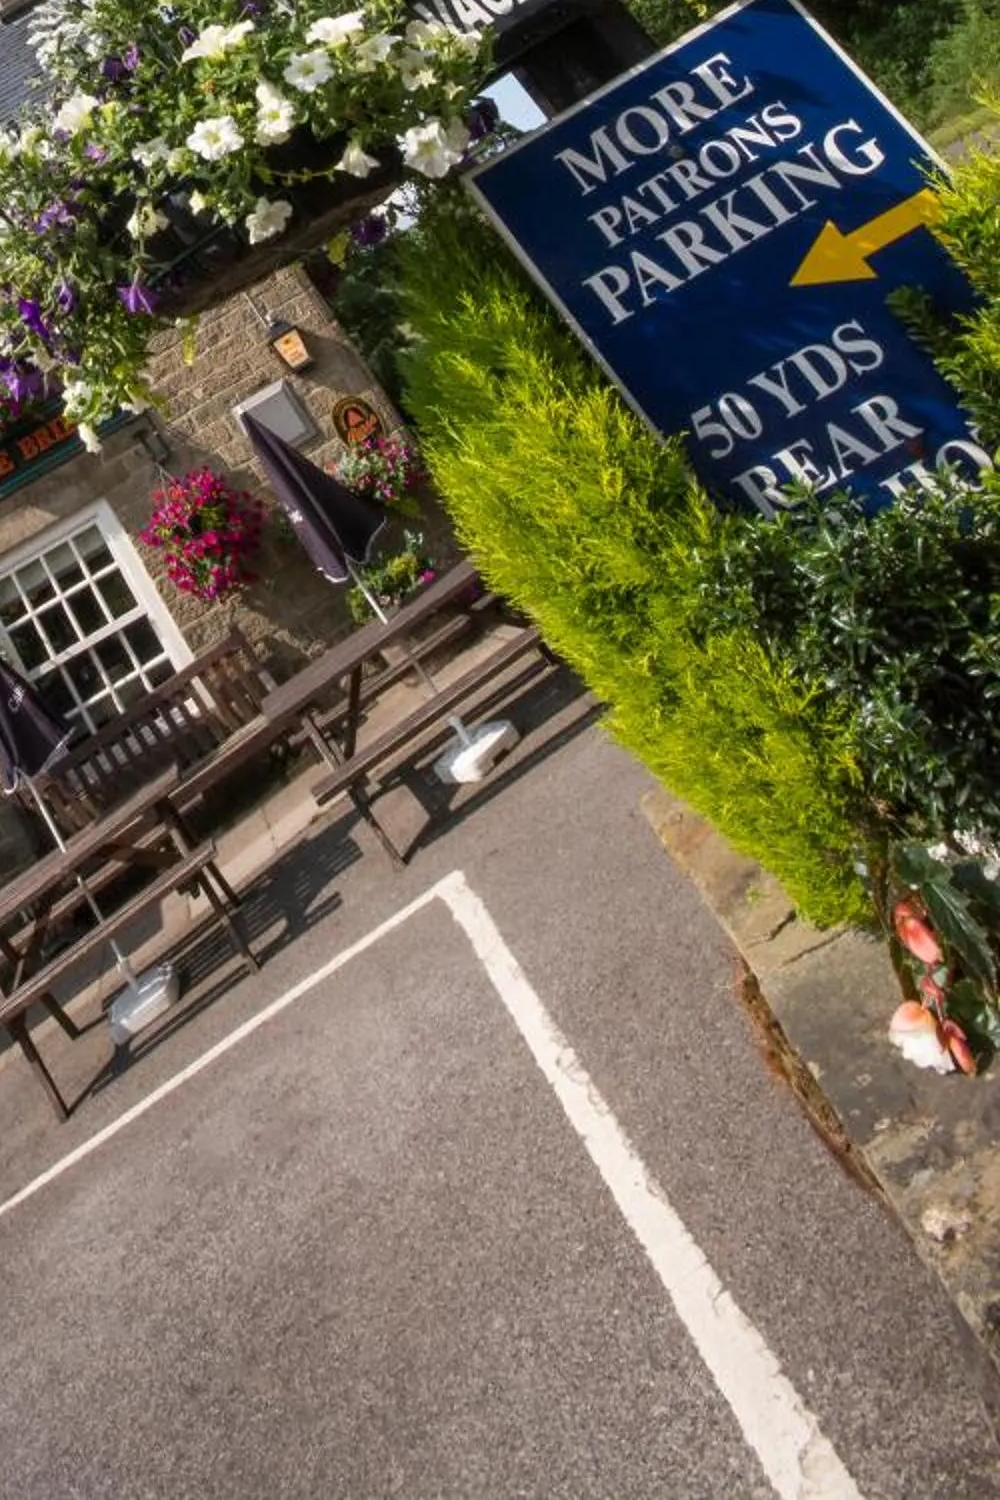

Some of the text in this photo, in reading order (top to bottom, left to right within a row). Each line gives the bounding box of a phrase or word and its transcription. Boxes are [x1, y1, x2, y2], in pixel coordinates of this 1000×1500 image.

[554, 52, 755, 196] MORE
[587, 101, 803, 248] PATRONS
[582, 118, 887, 325] PARKING
[691, 319, 884, 459] 50 YDS
[731, 395, 924, 520] REAR
